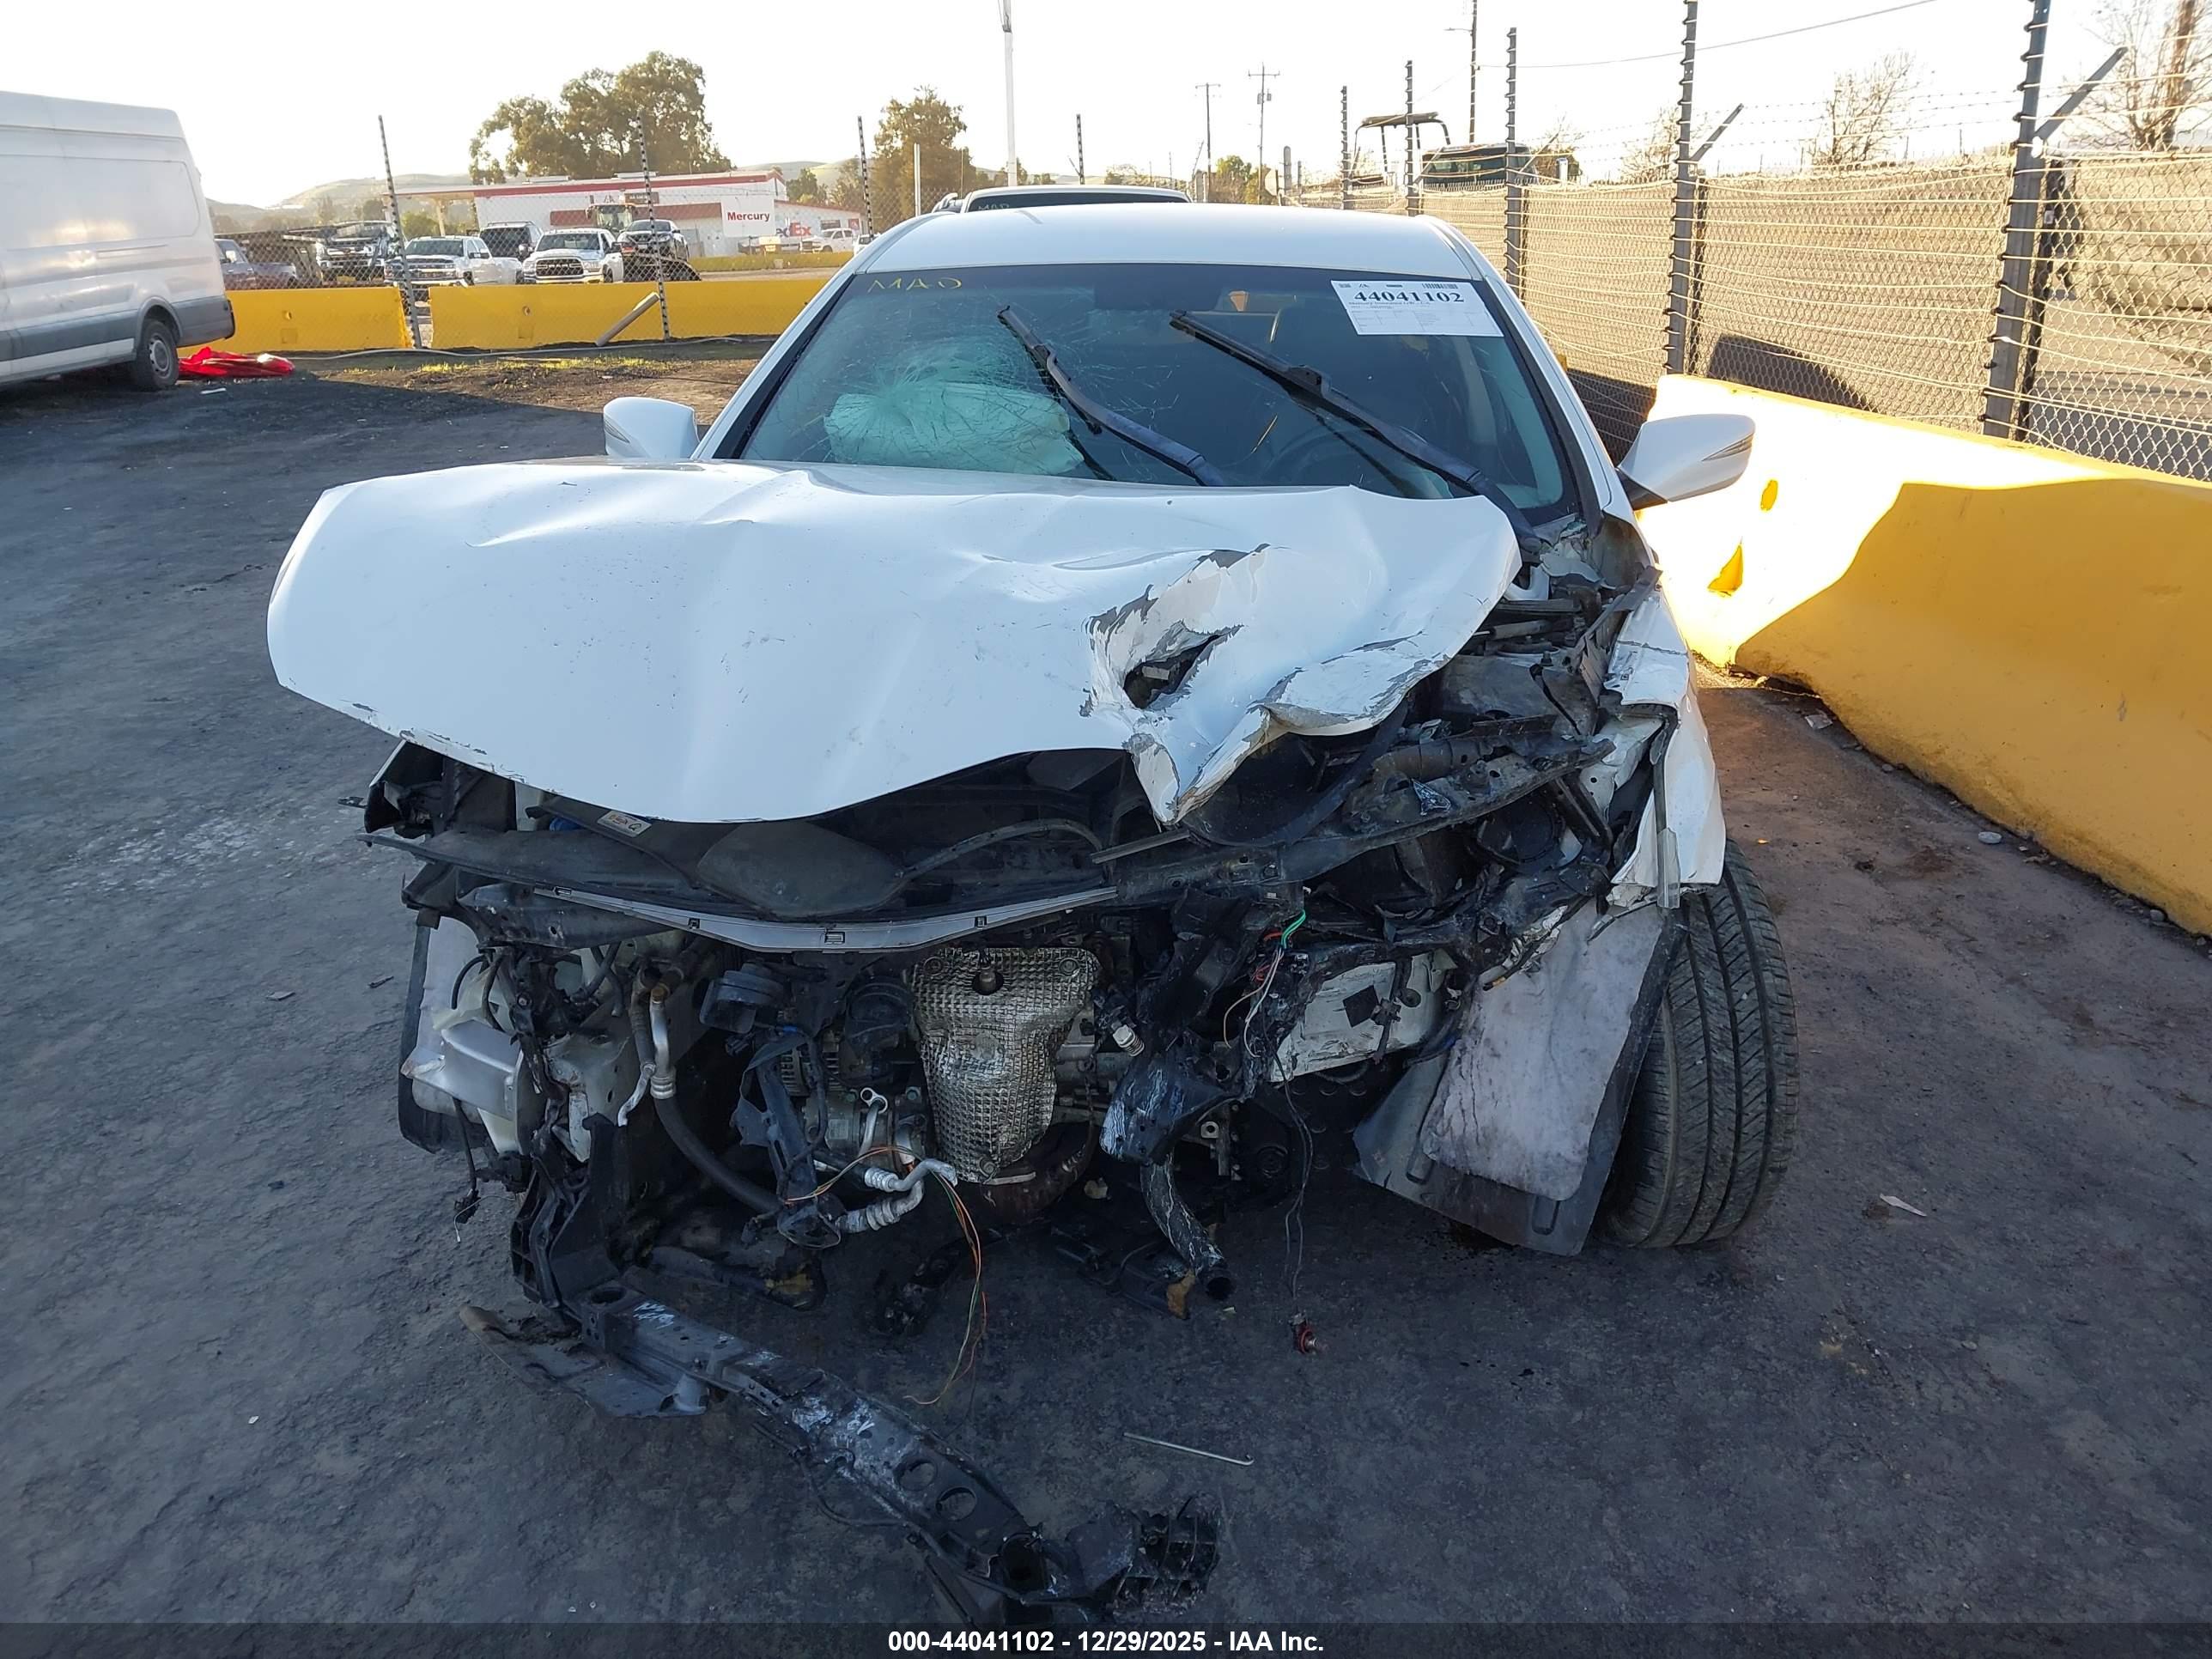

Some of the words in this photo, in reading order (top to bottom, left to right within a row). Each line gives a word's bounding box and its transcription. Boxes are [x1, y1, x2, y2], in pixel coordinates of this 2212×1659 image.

[726, 211, 770, 222] Mercury
[775, 222, 812, 237] edEx
[1353, 290, 1465, 303] 44041102
